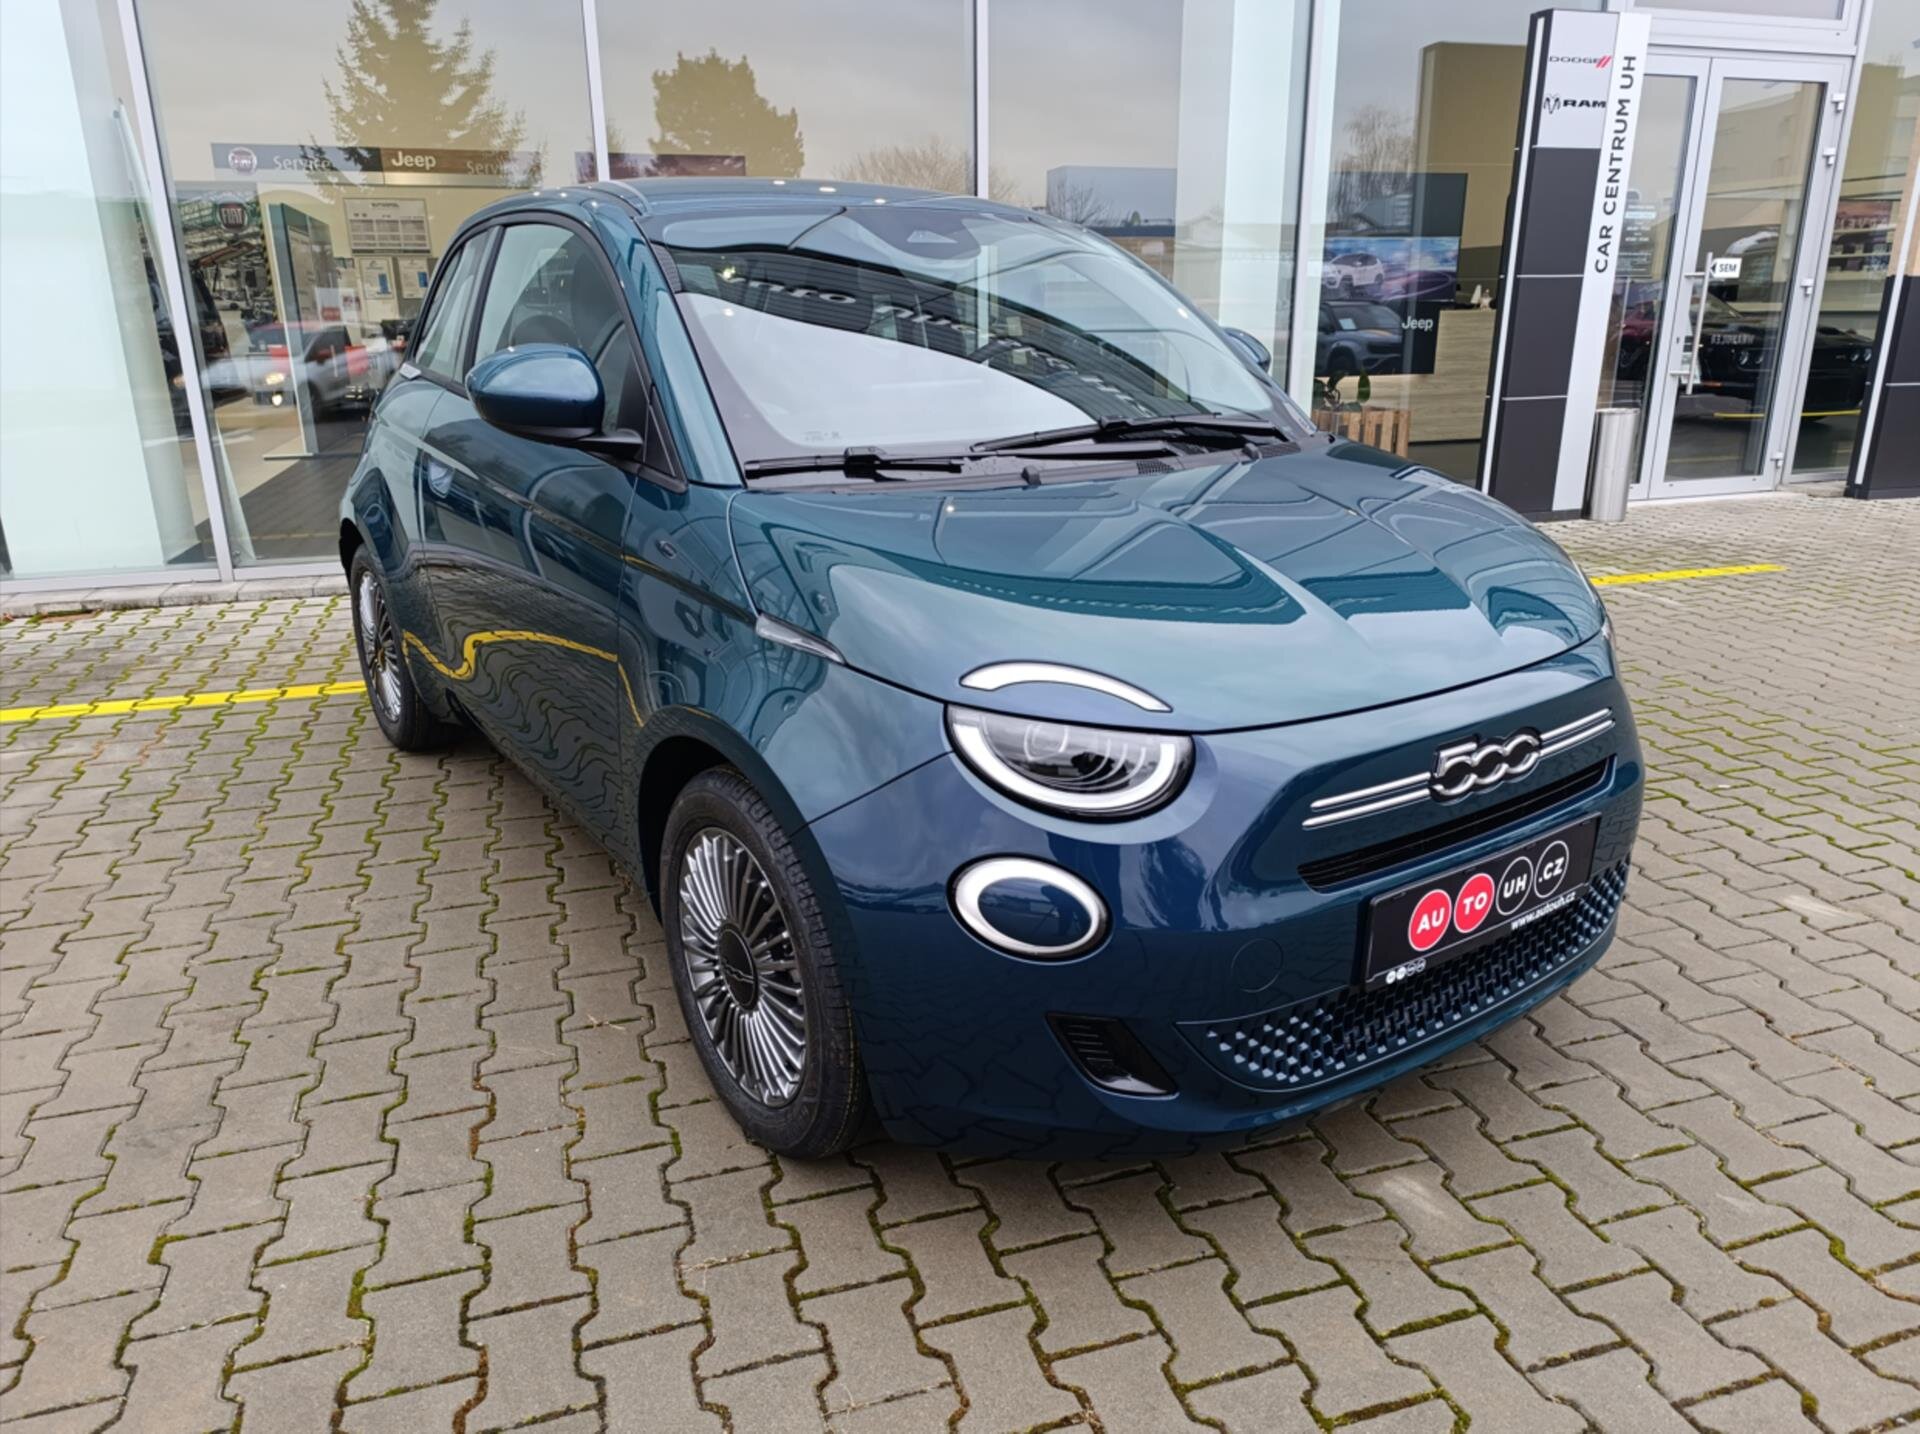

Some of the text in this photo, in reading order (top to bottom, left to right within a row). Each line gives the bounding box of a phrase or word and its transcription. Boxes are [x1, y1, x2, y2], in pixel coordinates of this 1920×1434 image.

[1549, 56, 1601, 64] DODGE
[1562, 100, 1606, 108] RAM
[391, 151, 436, 169] Jeep
[1595, 56, 1636, 273] CAR CENTRUM UH
[221, 207, 243, 225] FIAT
[1719, 264, 1737, 272] SEM
[1401, 315, 1434, 332] Jeep
[1432, 734, 1540, 796] 500
[1416, 857, 1565, 934] AU TO UH .CZ
